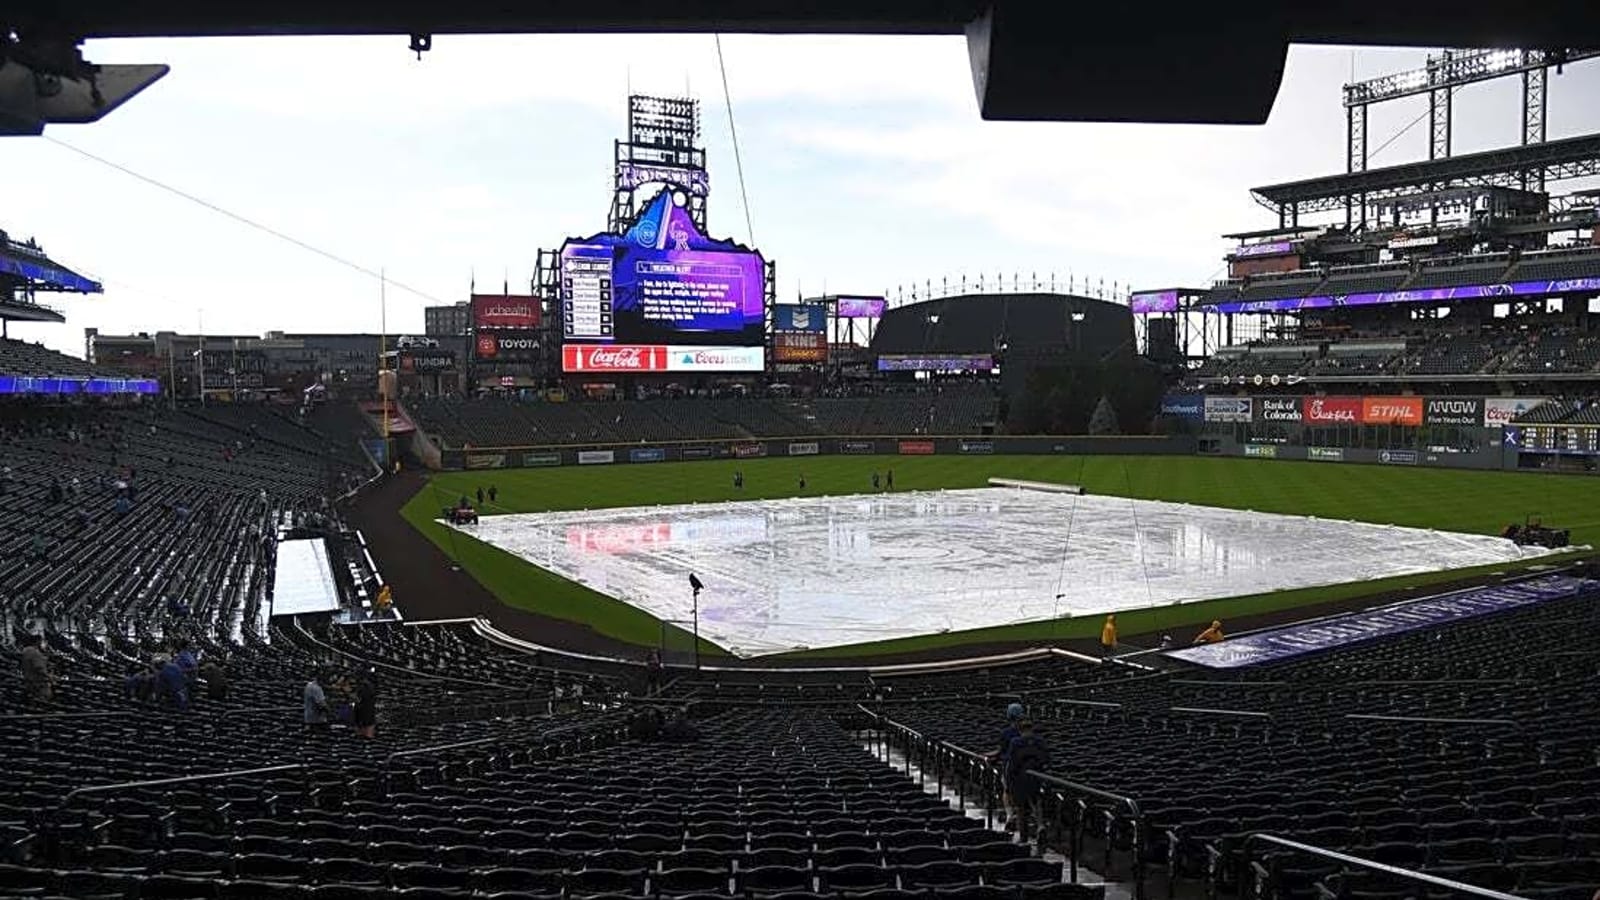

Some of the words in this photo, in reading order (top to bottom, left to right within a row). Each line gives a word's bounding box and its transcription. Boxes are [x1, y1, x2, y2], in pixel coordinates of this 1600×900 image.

[485, 303, 531, 317] uchealth
[499, 339, 540, 349] TOYOTA
[785, 335, 817, 347] KING
[414, 357, 452, 366] TUNDRA
[696, 351, 724, 365] Coors
[1162, 404, 1198, 415] Southwest
[1264, 400, 1284, 410] Bank
[1286, 400, 1295, 410] of
[1264, 410, 1303, 420] Colorado
[1369, 405, 1414, 417] STIHL
[1428, 416, 1442, 424] Five
[1443, 416, 1461, 424] Years
[1462, 416, 1476, 424] Out
